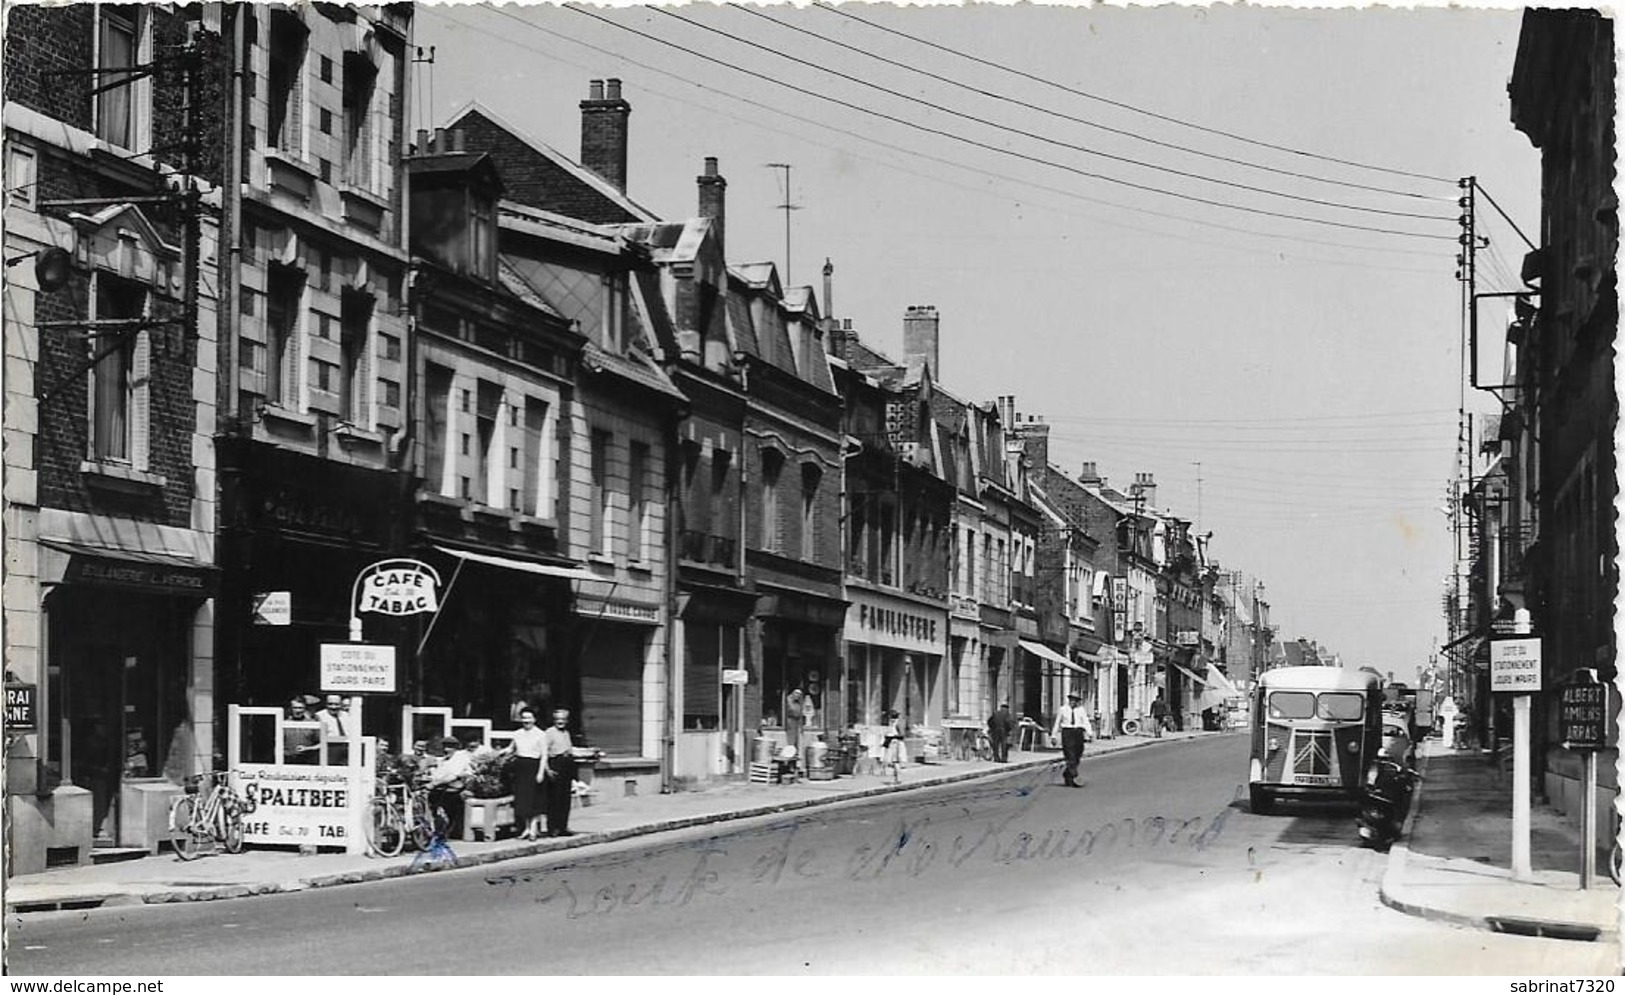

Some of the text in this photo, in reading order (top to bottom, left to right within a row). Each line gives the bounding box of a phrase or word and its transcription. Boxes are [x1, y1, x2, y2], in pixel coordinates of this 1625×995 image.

[369, 595, 428, 613] TABAC
[326, 663, 390, 673] STATIONNEMENT
[1494, 660, 1538, 670] STATIONNEMENT
[330, 675, 386, 685] JOURS PAIRS
[1494, 675, 1512, 685] JOURS
[1563, 687, 1601, 703] ALBERT
[1564, 706, 1601, 720] AMIENS
[1566, 725, 1598, 740] ARRAS
[318, 825, 349, 838] TAB
